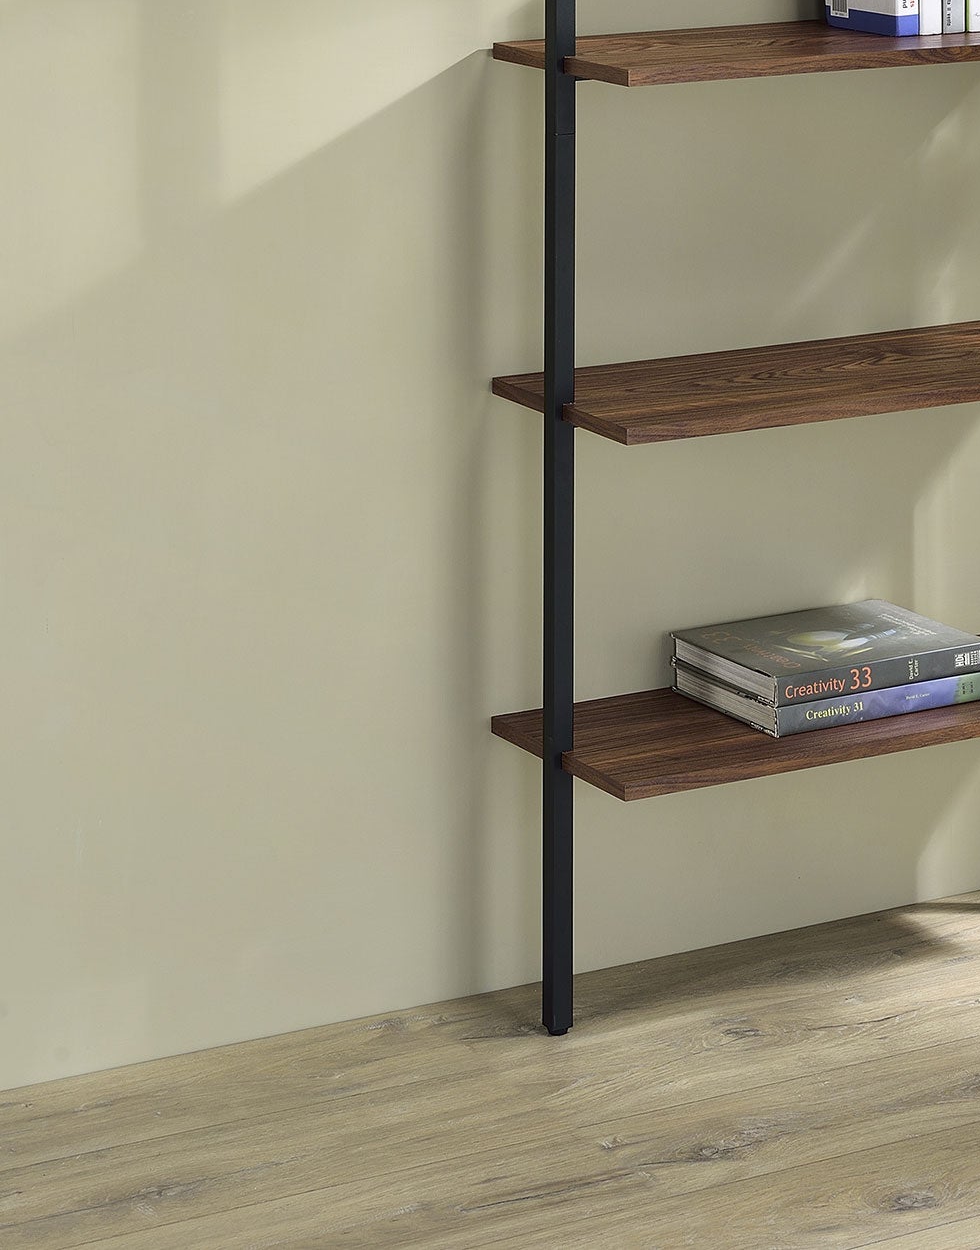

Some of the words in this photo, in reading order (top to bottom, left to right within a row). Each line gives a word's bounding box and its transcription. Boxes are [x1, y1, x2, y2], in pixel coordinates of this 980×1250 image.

[785, 677, 846, 700] Creativity
[850, 667, 873, 690] 33
[805, 703, 851, 721] Creativity
[853, 702, 864, 713] 31
